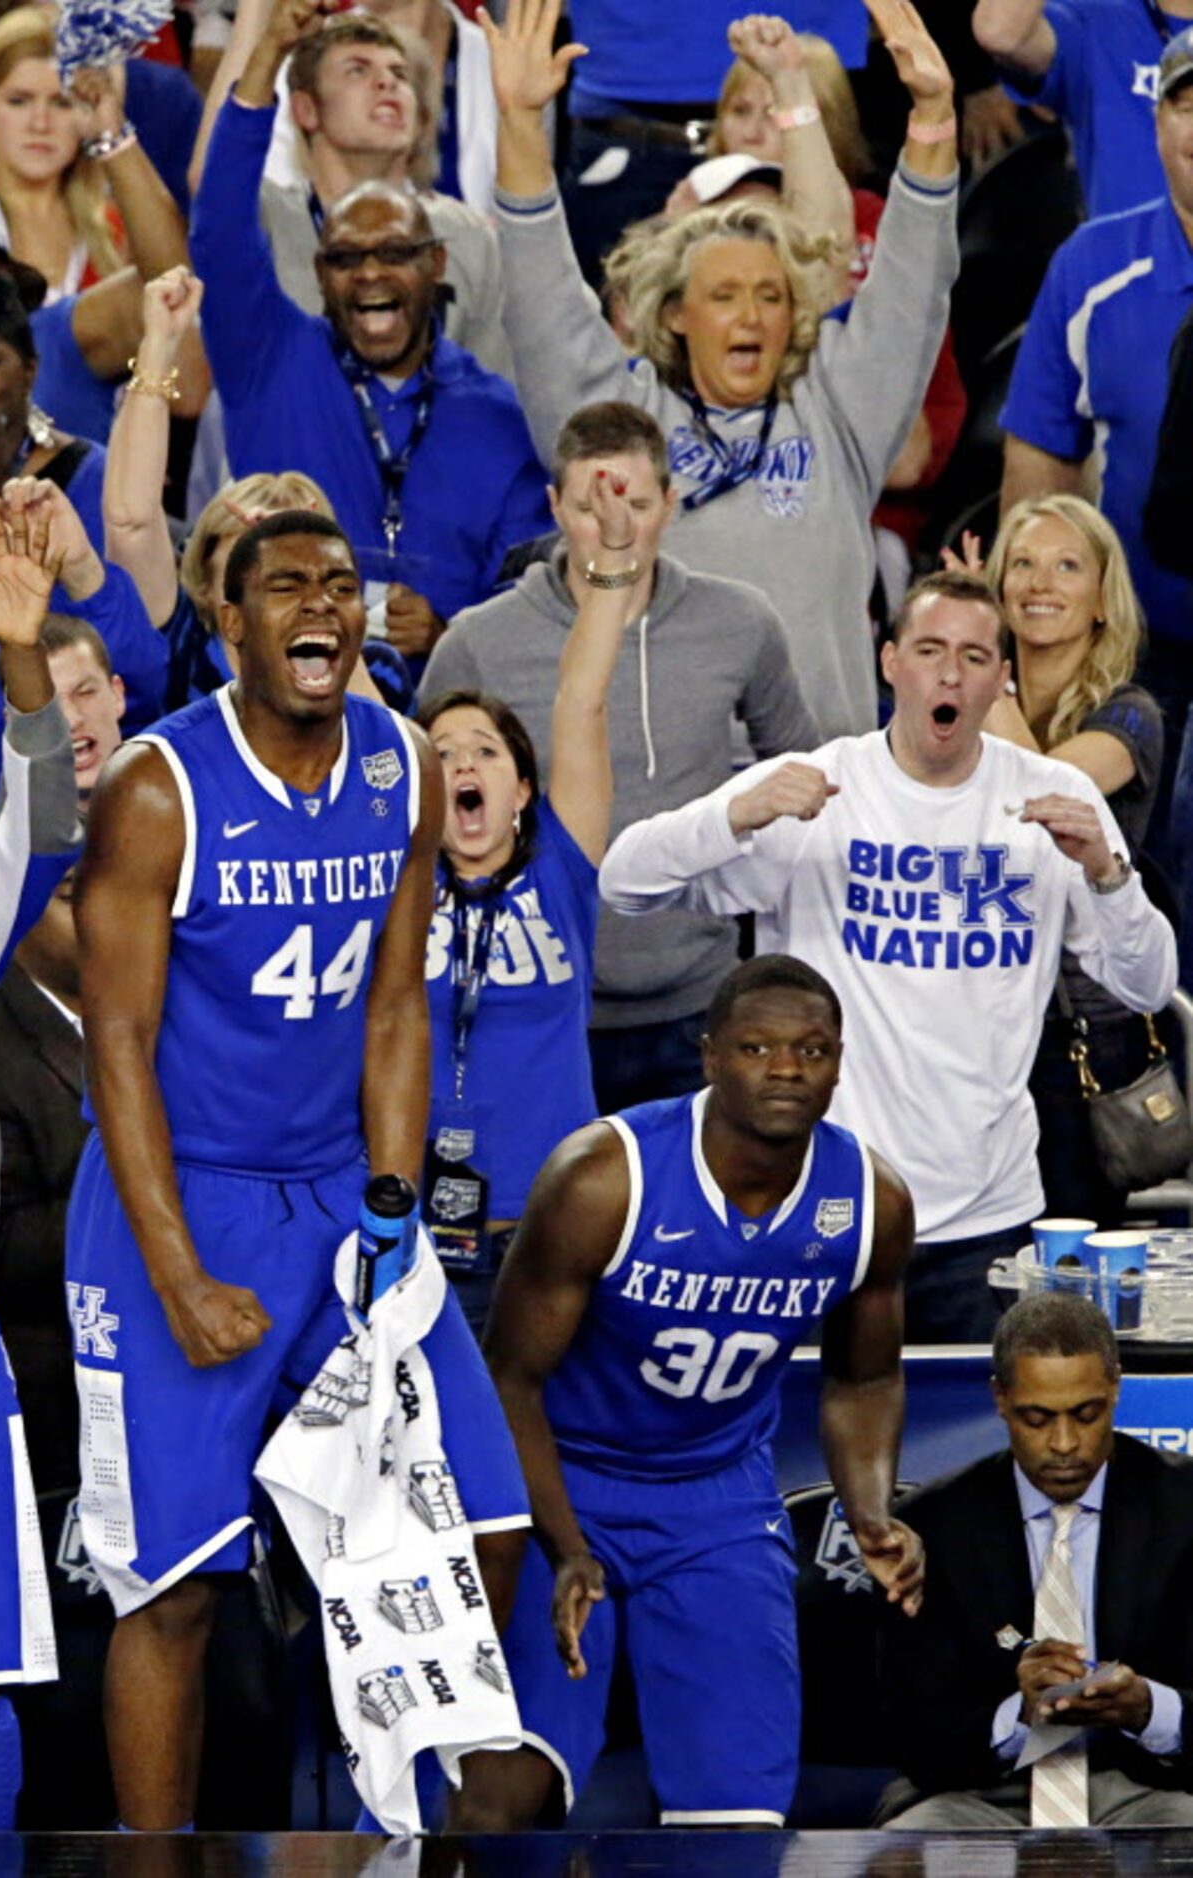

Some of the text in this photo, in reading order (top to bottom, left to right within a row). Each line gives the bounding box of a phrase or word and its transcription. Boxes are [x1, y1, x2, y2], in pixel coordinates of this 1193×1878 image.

[217, 848, 405, 905] KENTUCKY
[849, 838, 936, 883] BIG
[935, 843, 1035, 928] UK
[846, 881, 940, 922] BLUE
[250, 919, 374, 1020] 44
[841, 918, 1034, 970] NATION
[620, 1260, 837, 1318] KENTUCKY
[639, 1327, 781, 1404] 30
[447, 1556, 484, 1611] NCAA
[325, 1598, 362, 1652] NCAA
[418, 1659, 457, 1708] NCAA
